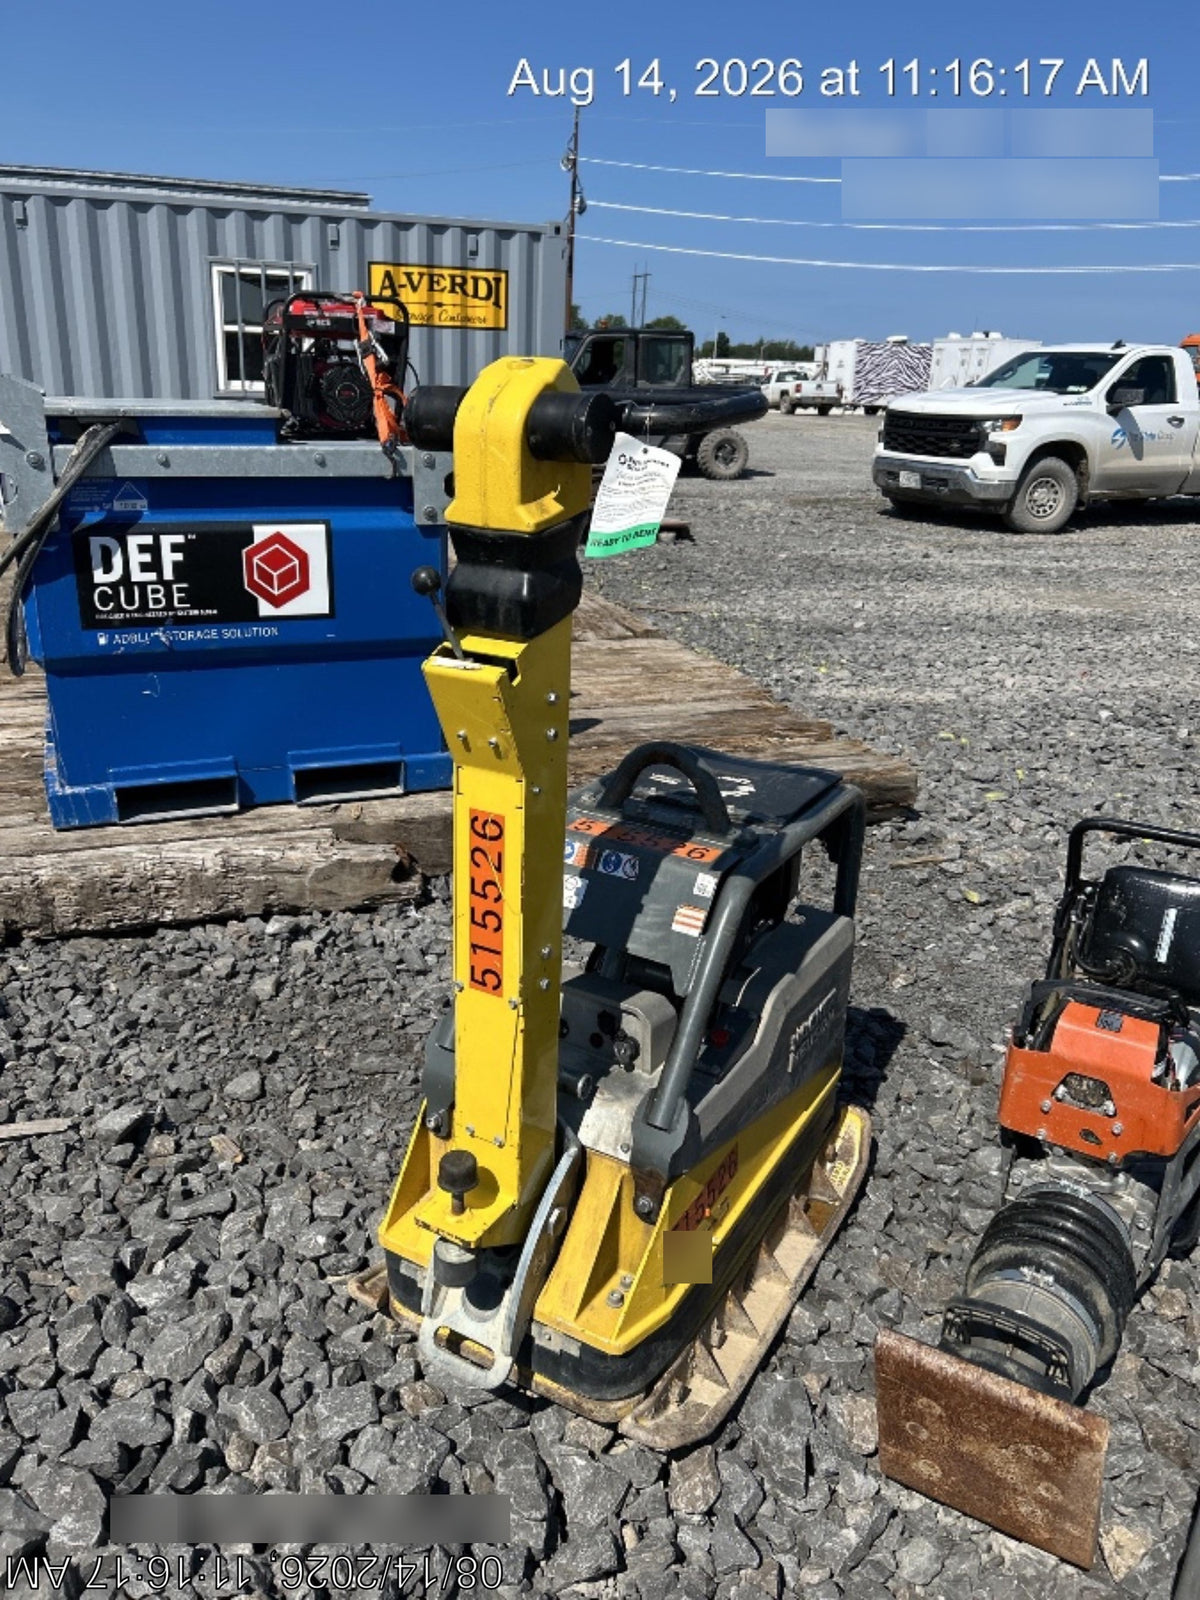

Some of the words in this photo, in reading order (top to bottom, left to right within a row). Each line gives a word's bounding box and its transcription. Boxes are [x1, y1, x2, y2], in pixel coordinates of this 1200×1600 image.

[379, 270, 502, 309] A-VERDI
[93, 583, 191, 612] CUBE
[221, 626, 280, 640] SOLUTION
[469, 814, 504, 991] 515526
